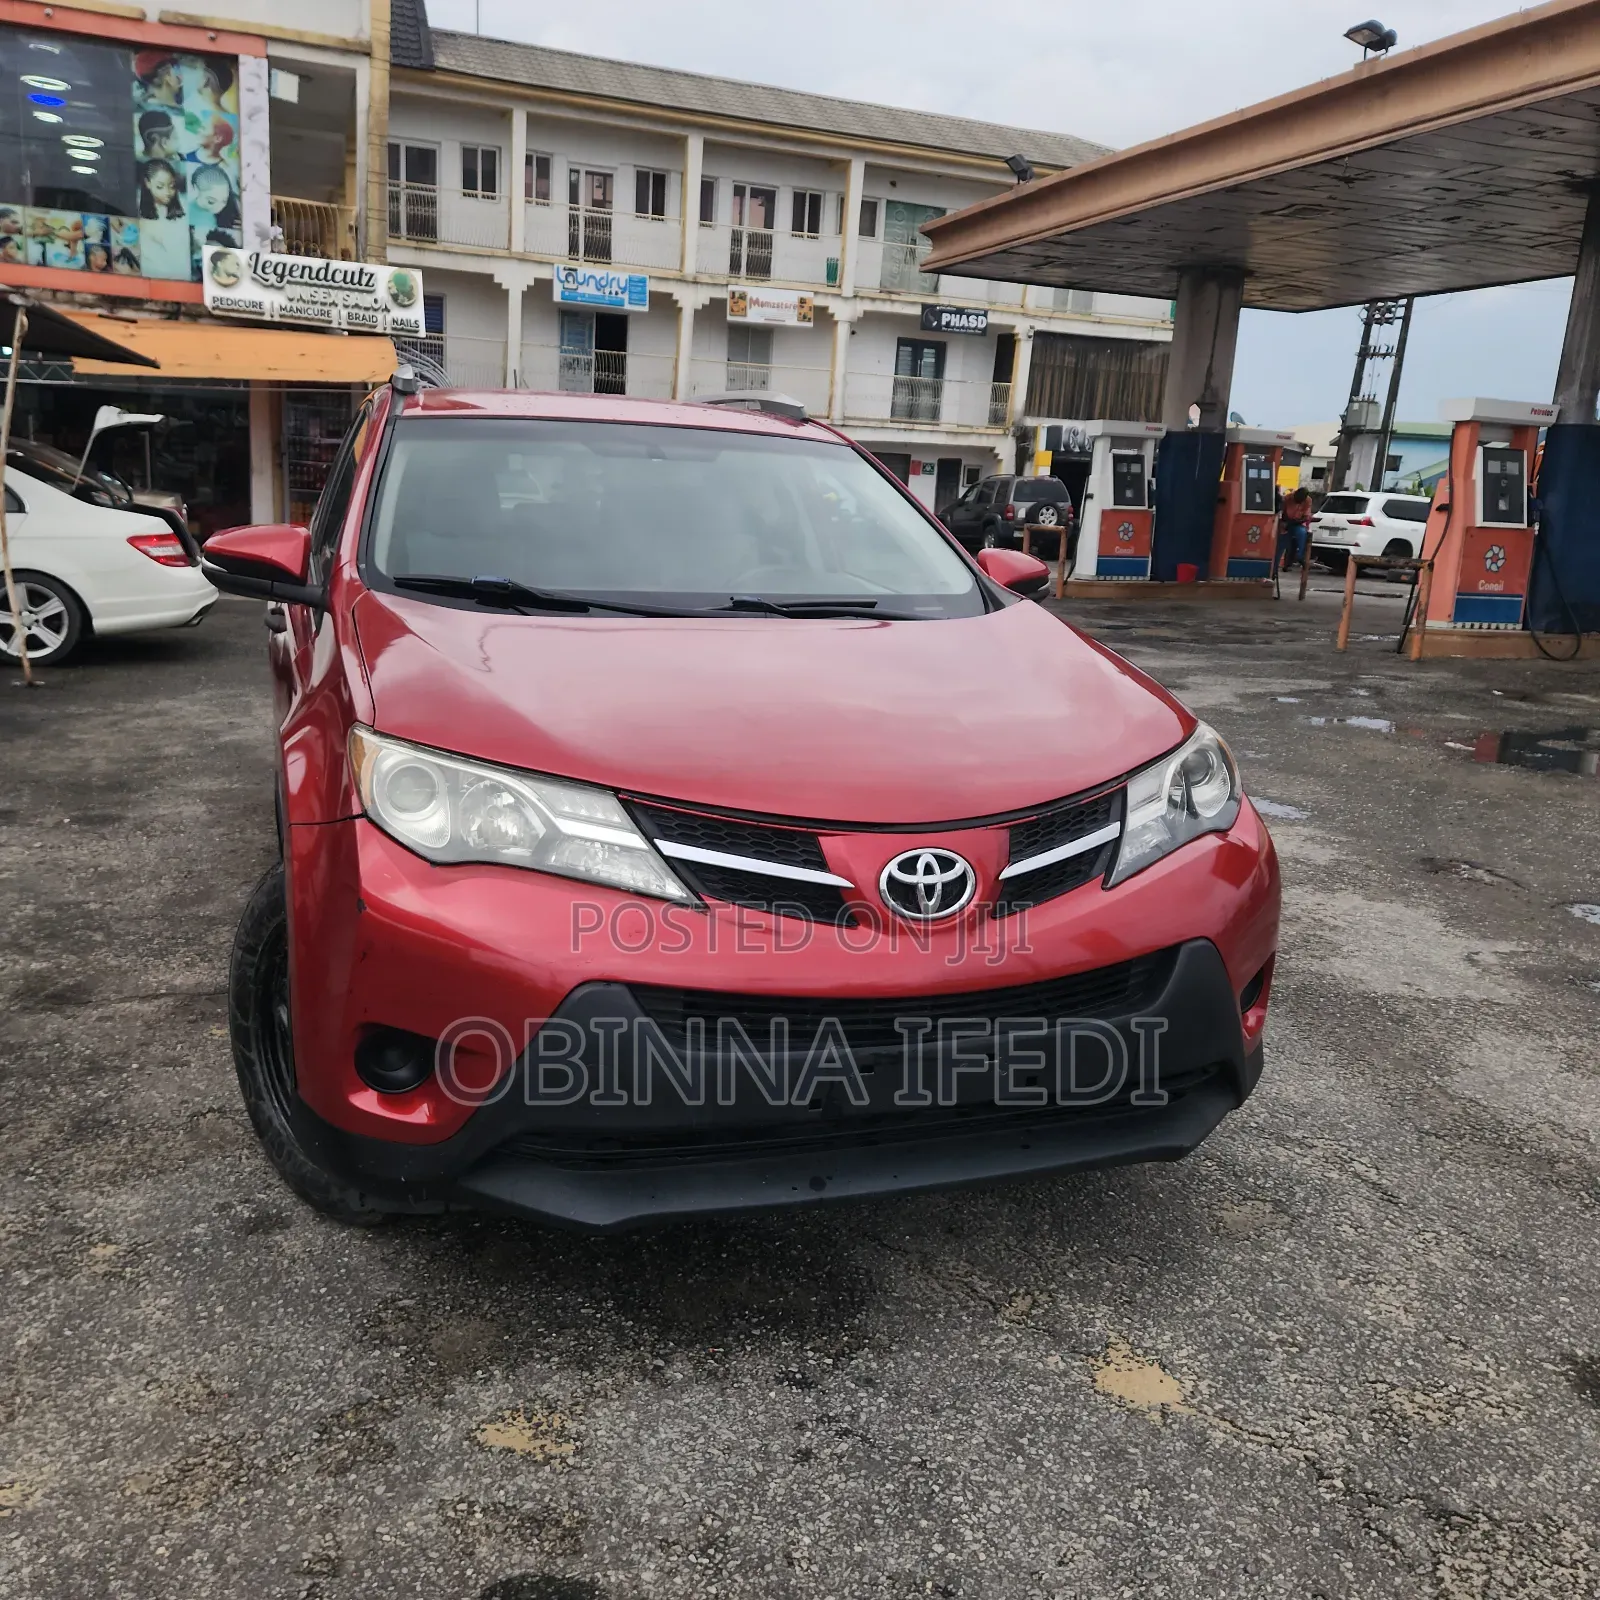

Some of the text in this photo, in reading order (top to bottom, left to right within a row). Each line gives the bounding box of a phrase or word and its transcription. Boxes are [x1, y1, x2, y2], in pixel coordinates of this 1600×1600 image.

[248, 252, 377, 288] Legendcutz
[556, 265, 628, 294] Laundry
[286, 284, 338, 307] UNISEX
[212, 296, 420, 329] PEDICURE MANICURE BRAID NAILS
[941, 312, 987, 329] PHASD
